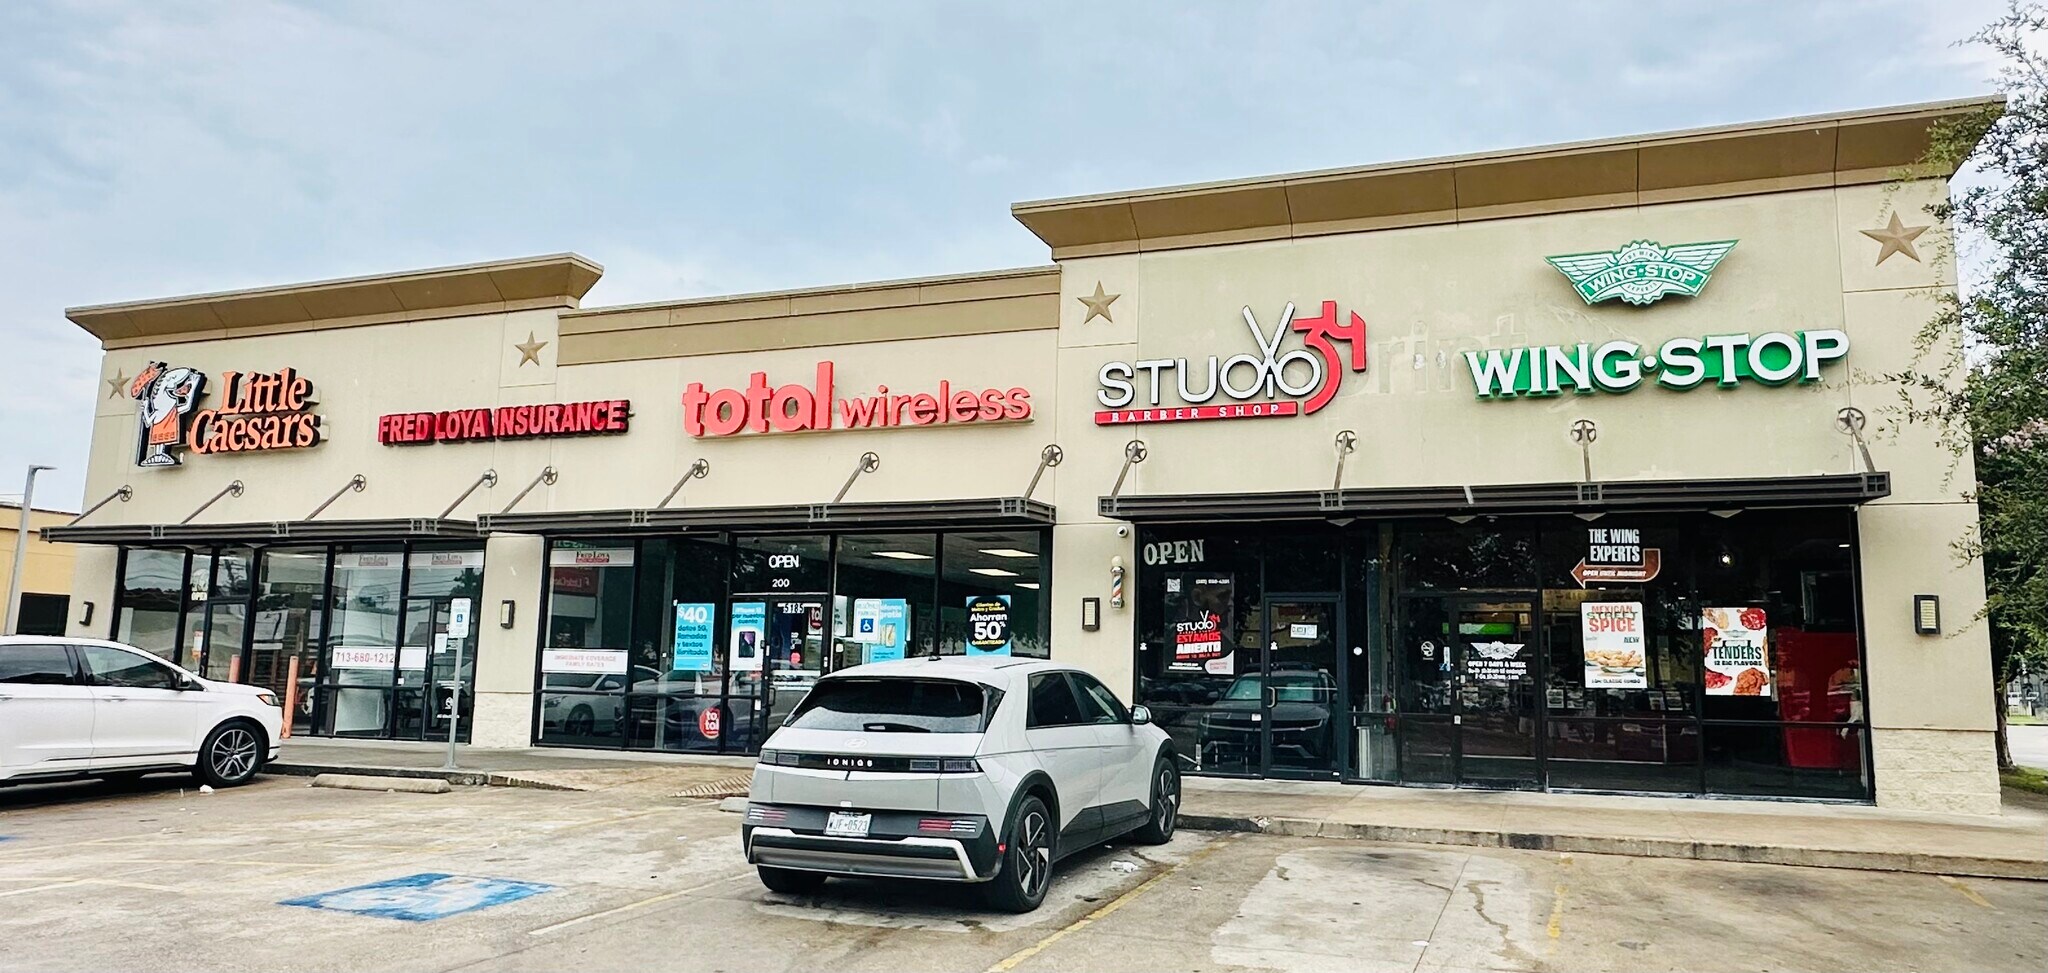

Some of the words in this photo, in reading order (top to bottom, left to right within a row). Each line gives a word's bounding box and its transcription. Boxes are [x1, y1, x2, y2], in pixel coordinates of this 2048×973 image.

[1292, 300, 1366, 415] 34
[217, 367, 311, 415] Little
[682, 360, 834, 437] total
[840, 380, 1032, 428] wireless
[1111, 407, 1200, 423] BARBER
[1218, 403, 1280, 418] SHOP
[379, 411, 434, 444] FRED
[434, 408, 493, 441] LOYA
[493, 400, 630, 439] INSURANCE
[189, 408, 318, 454] Caesars
[1588, 528, 1608, 544] THE
[1610, 528, 1640, 544] WING
[1143, 539, 1205, 566] OPEN
[1590, 545, 1640, 562] EXPERTS
[768, 555, 800, 569] OPEN
[772, 579, 790, 588] 200
[677, 605, 708, 624] $40
[970, 613, 1008, 622] Ahorran
[1591, 605, 1633, 613] MEXICAN
[1589, 618, 1636, 632] SPICE
[1176, 631, 1221, 643] ESTAMOS
[1712, 646, 1763, 660] TENDERS
